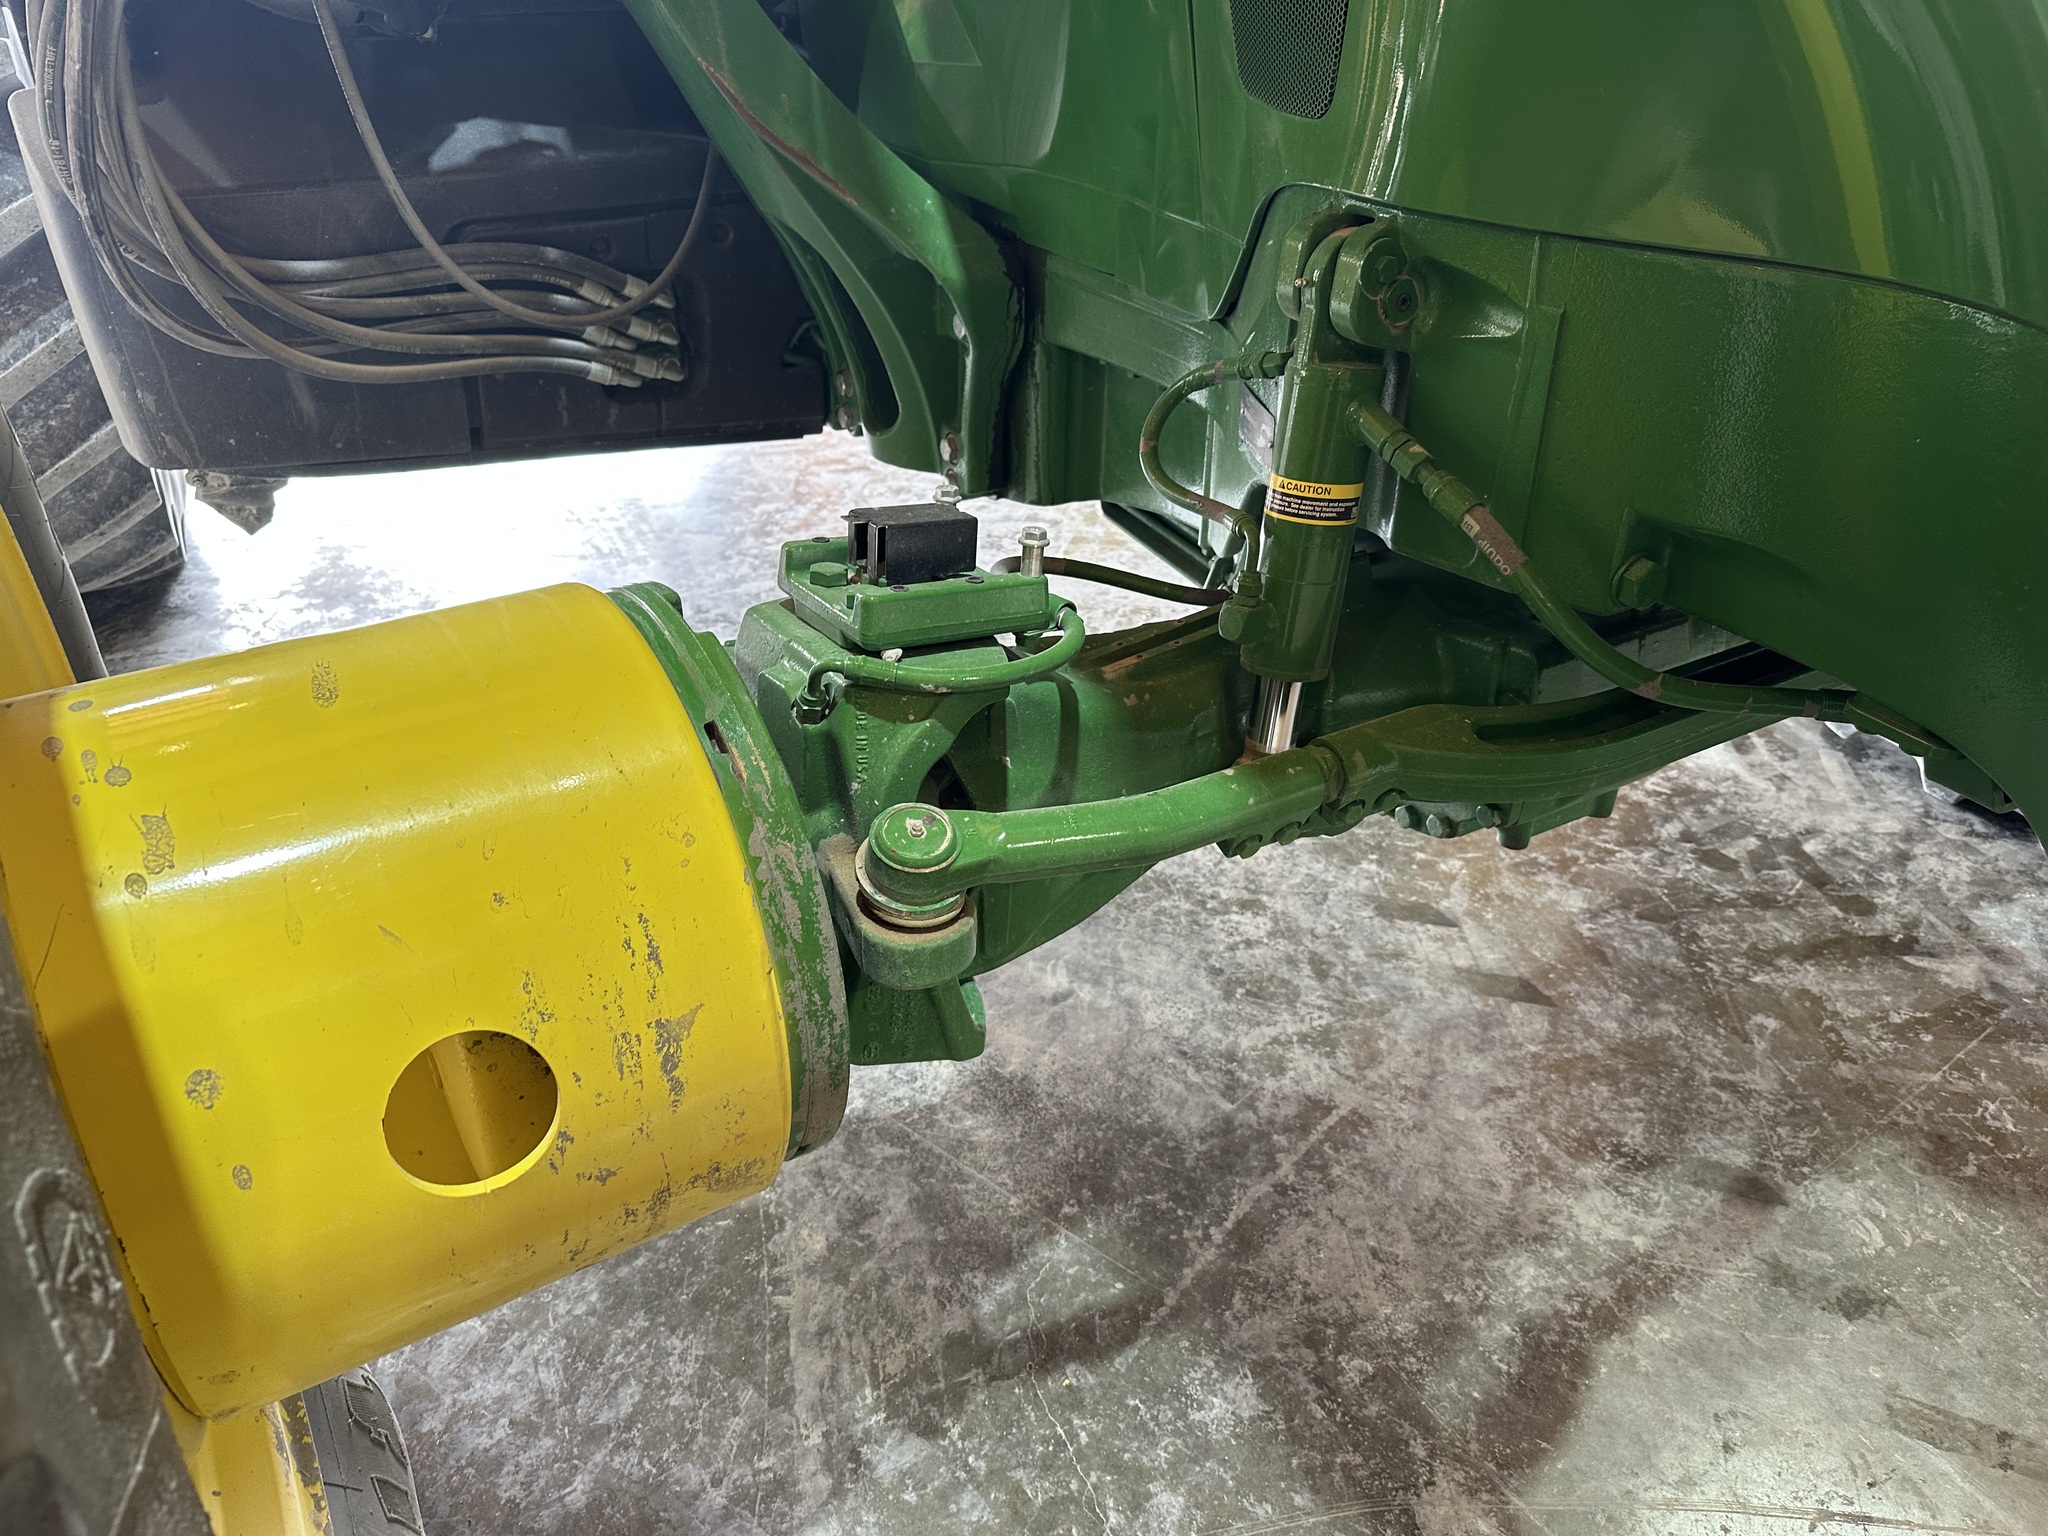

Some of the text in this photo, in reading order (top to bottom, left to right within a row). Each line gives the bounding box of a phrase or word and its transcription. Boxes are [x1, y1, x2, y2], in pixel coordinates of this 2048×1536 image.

[1286, 482, 1331, 495] CAUTION
[1302, 499, 1328, 507] movement
[1284, 506, 1298, 514] before
[1298, 509, 1320, 518] servicing
[856, 735, 868, 752] IN
[856, 755, 868, 784] USA
